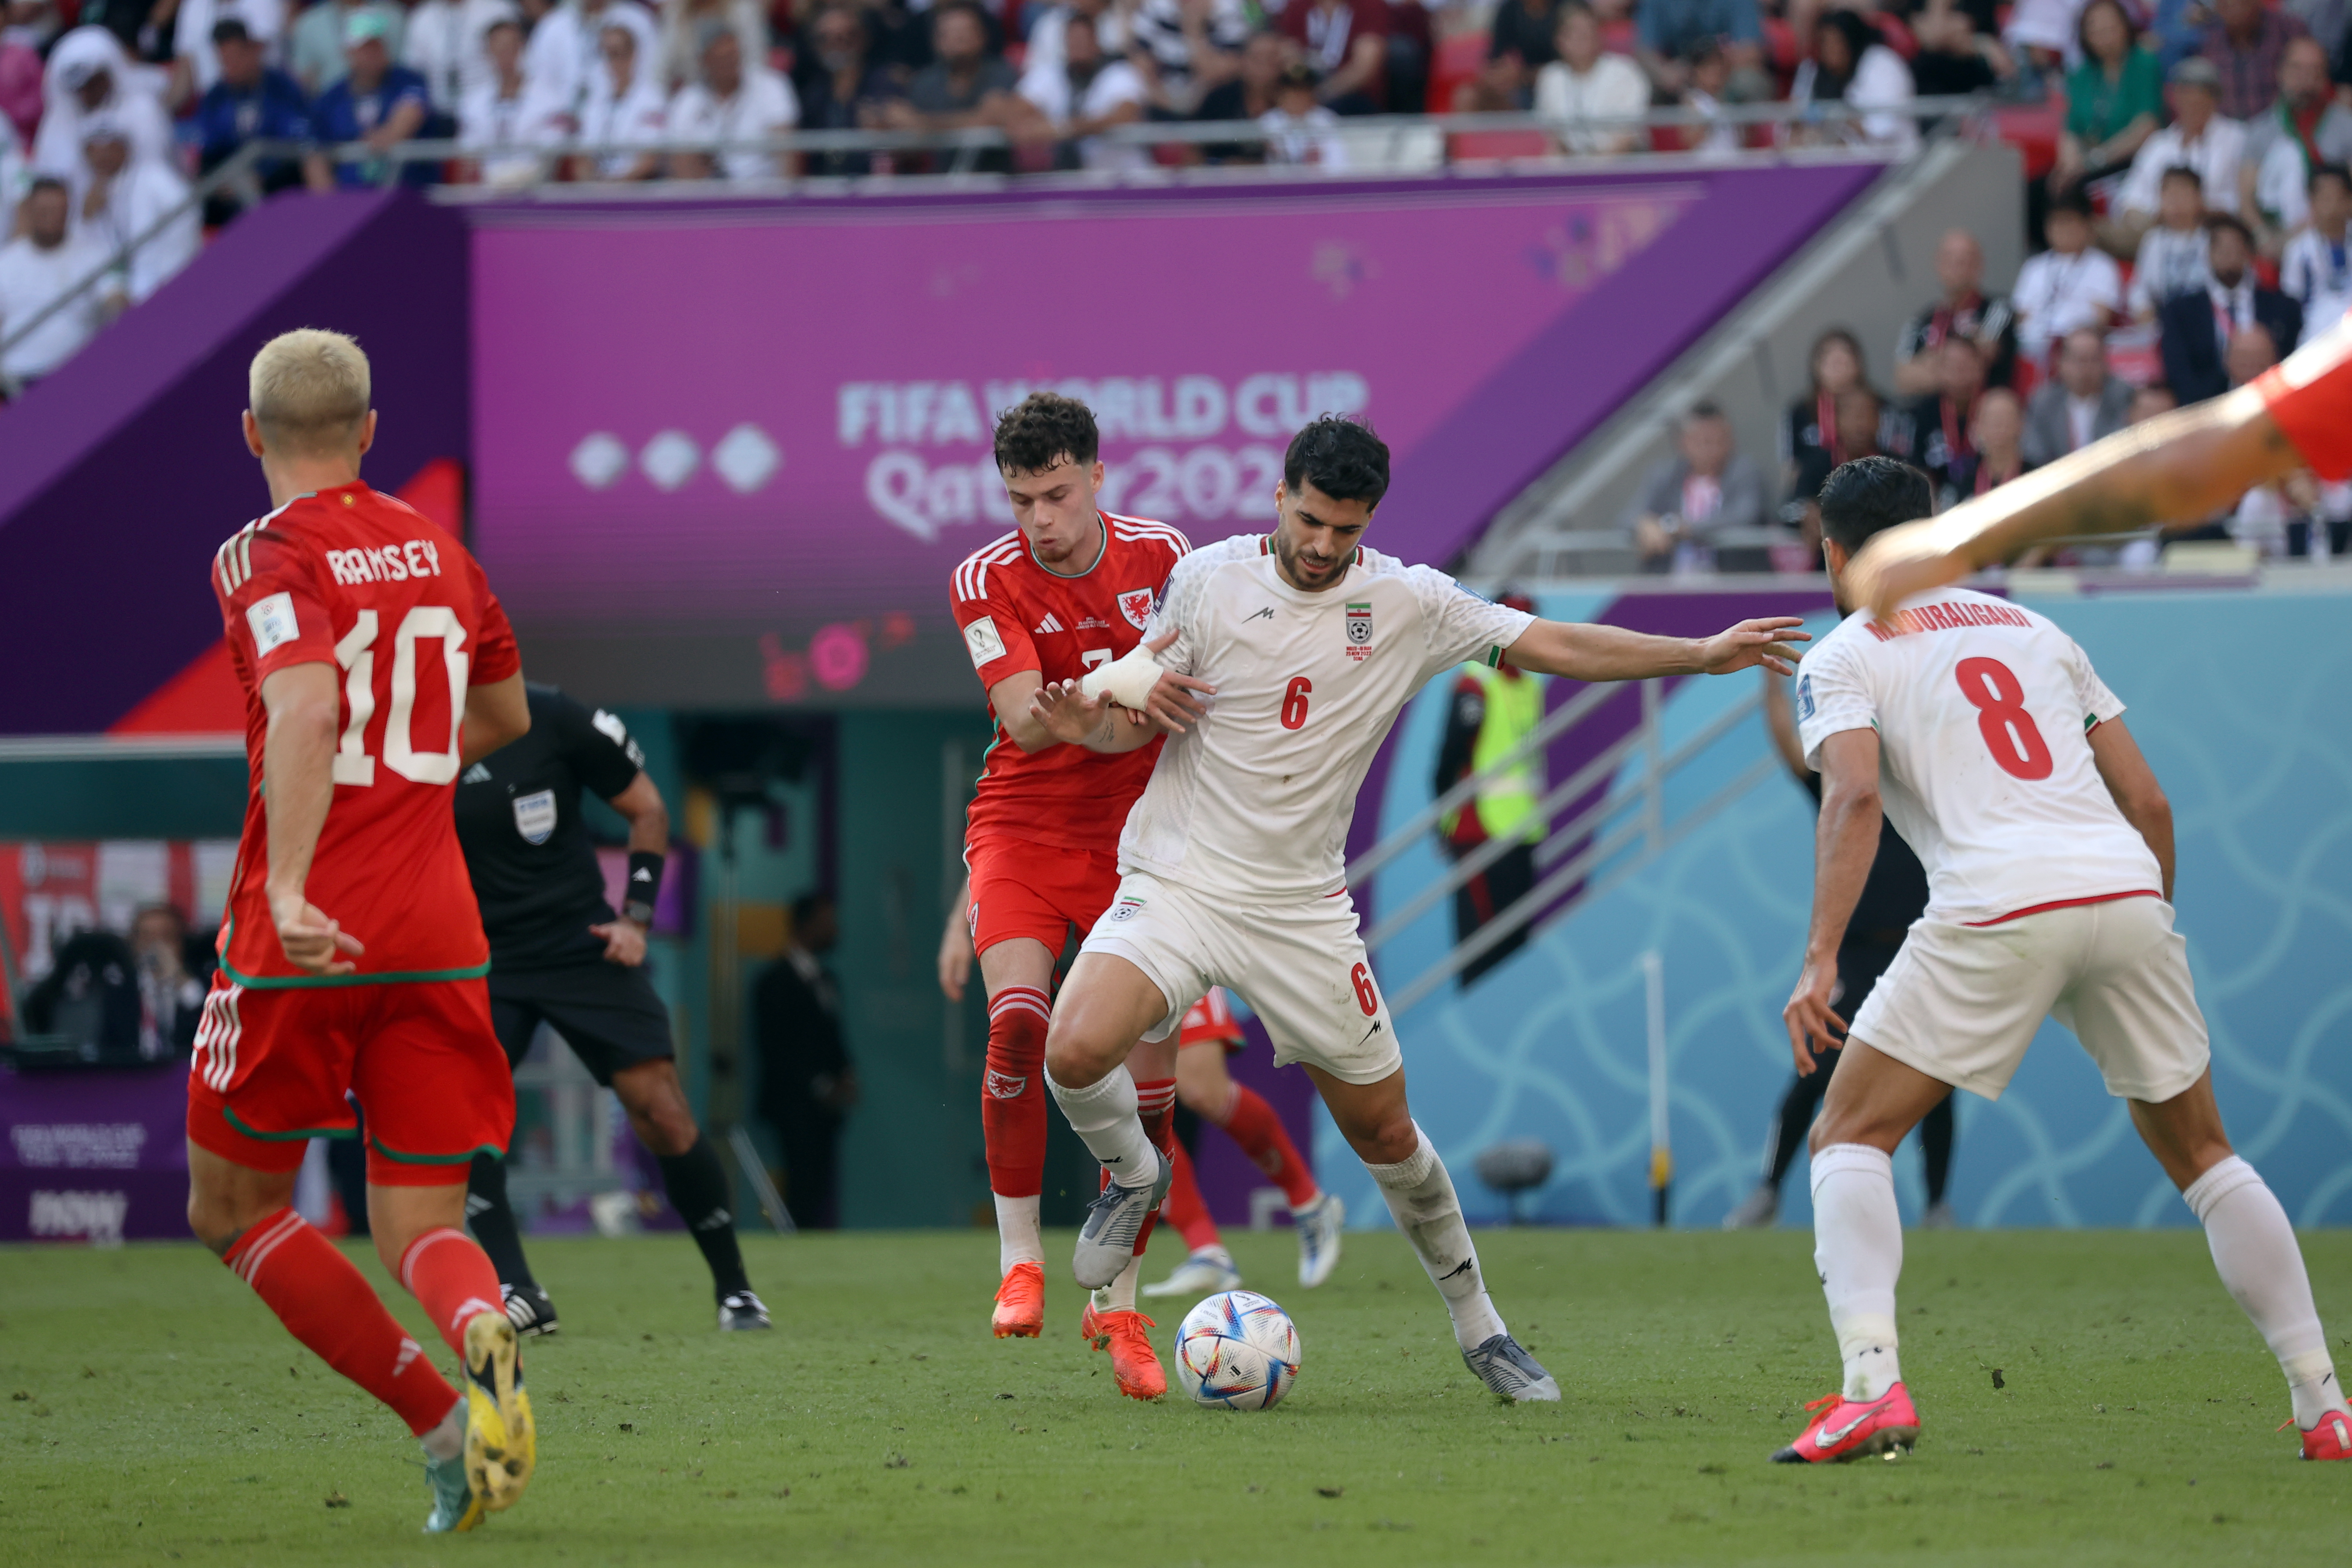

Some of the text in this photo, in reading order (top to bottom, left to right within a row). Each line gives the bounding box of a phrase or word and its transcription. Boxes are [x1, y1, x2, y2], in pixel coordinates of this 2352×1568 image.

[836, 371, 1369, 446] FIFA RLD CUP
[325, 539, 441, 586] RAMSEY
[332, 606, 469, 787] 10
[1280, 677, 1312, 730] 6
[1955, 656, 2053, 781] 8
[1351, 962, 1377, 1017] 6
